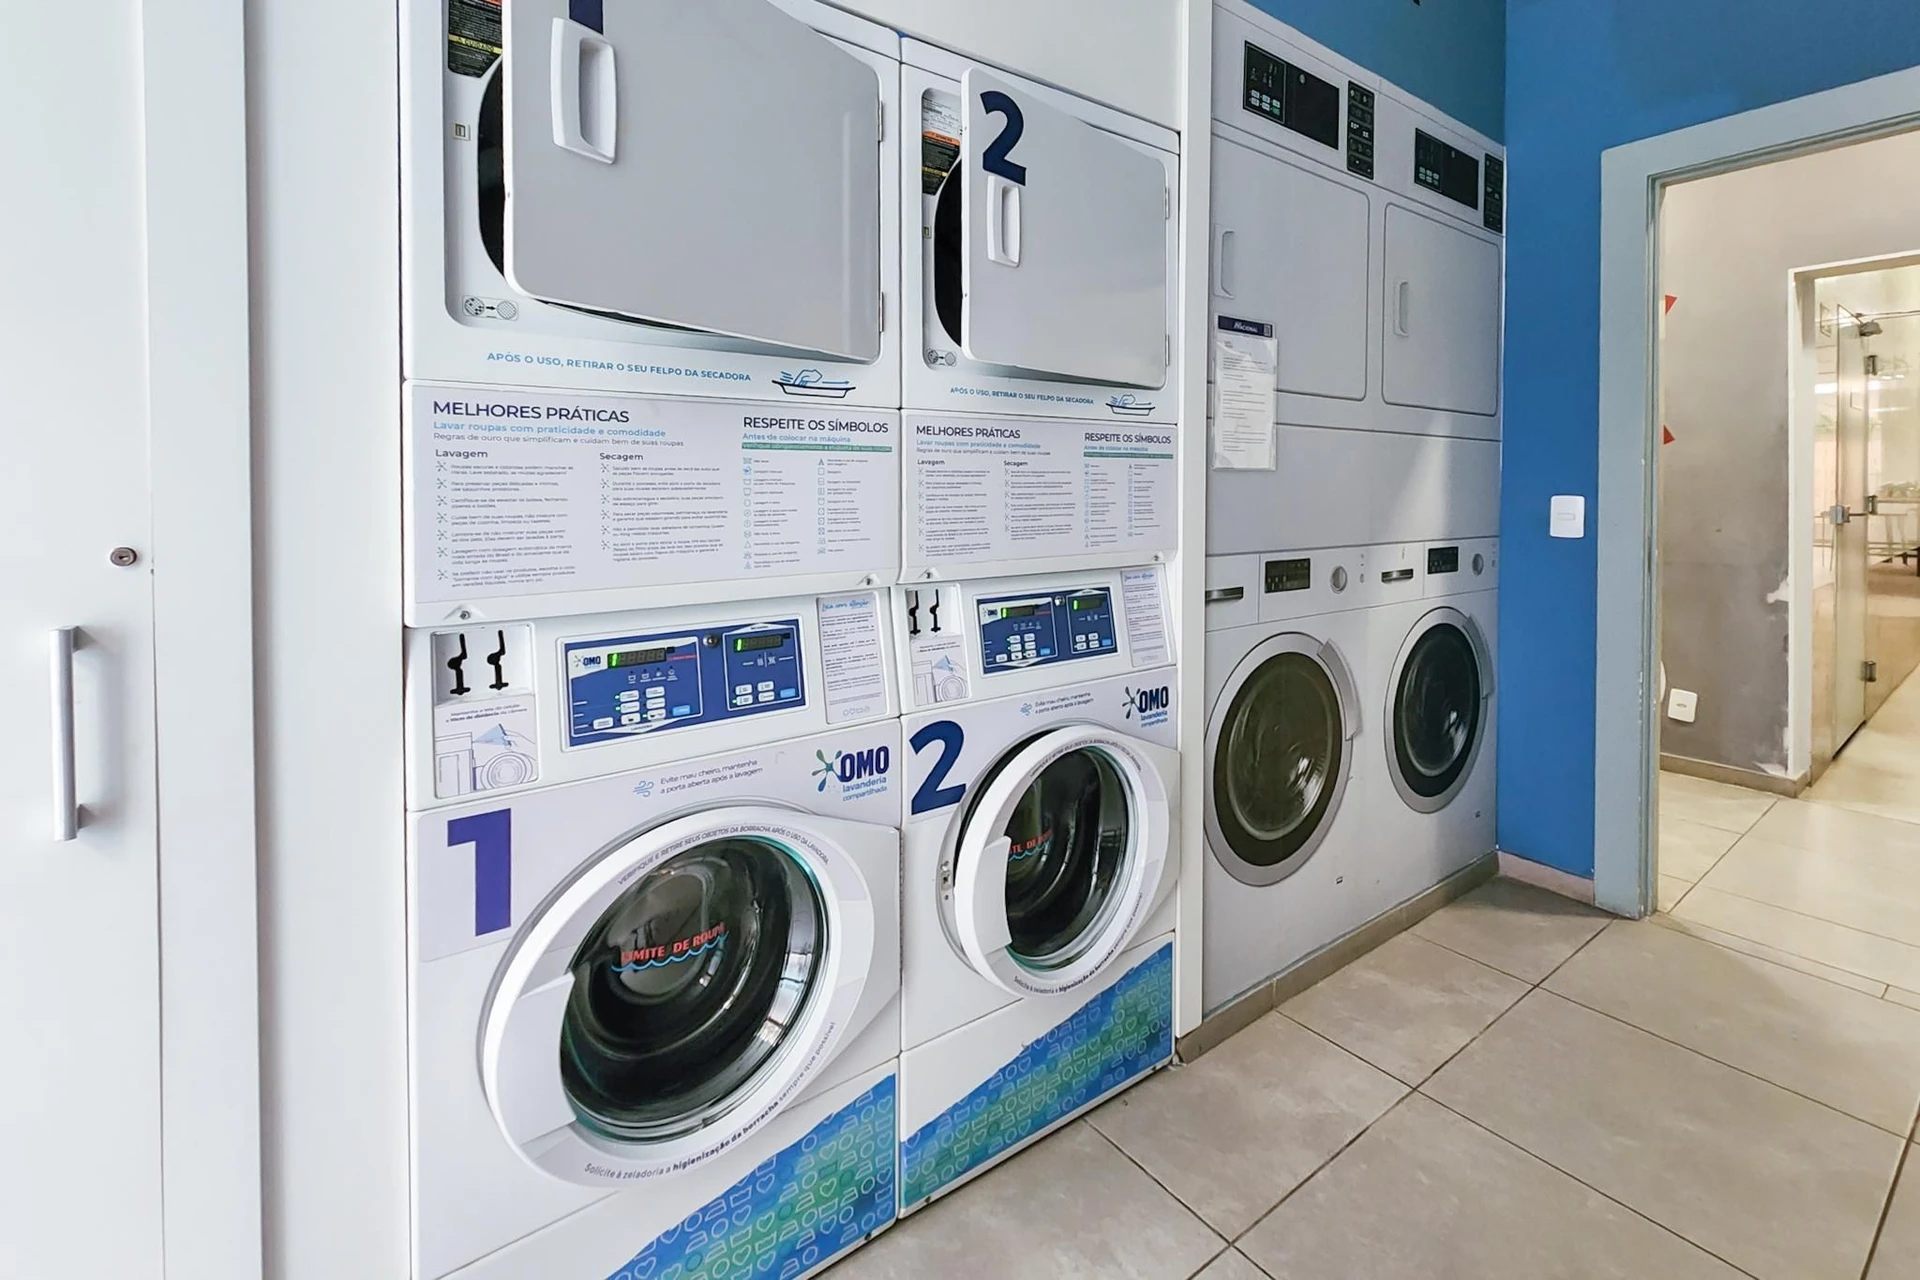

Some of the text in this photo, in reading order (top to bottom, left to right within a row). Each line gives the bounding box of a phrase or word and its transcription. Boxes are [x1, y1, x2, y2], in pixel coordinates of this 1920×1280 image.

[980, 90, 1027, 187] 2
[487, 352, 751, 381] APÓS O USO, RETIRAR O SEU FELPO DA SECADORA
[950, 387, 968, 395] APÓS
[992, 390, 1017, 399] RETIRAR
[1065, 396, 1094, 404] SECADORA
[434, 401, 630, 423] MELHORES PRÁTICAS
[434, 421, 465, 430] Lavar
[468, 424, 507, 432] roupas
[537, 426, 595, 434] praticidade
[607, 428, 666, 437] comodidade
[743, 416, 889, 433] RESPEITE OS SÍMBOLOS
[916, 425, 1020, 438] MELHORES PRÁTICAS
[434, 432, 465, 441] Regras
[820, 435, 851, 443] máquina
[1084, 432, 1171, 444] RESPEITE OS SÍMBOLOS
[435, 449, 488, 459] Lavagem
[599, 452, 644, 461] Secagem
[583, 655, 601, 666] OMO
[1140, 686, 1169, 713] OMO
[661, 776, 678, 784] Evite
[722, 760, 757, 771] mantenha
[839, 746, 889, 783] OMO
[909, 720, 967, 815] 2
[666, 784, 686, 793] porta
[687, 779, 710, 788] aberta
[711, 775, 728, 783] após
[734, 767, 763, 777] lavagem
[842, 777, 887, 793] lavanderia
[843, 786, 888, 802] compartilhada
[618, 857, 654, 885] VERIFIQUE
[661, 841, 683, 855] RETIRE
[684, 834, 701, 844] SEUS
[701, 827, 730, 839] OBJETOS
[740, 825, 771, 833] BORRACHA
[772, 827, 785, 836] APÓS
[791, 832, 801, 841] USO
[447, 808, 511, 936] 1
[621, 945, 665, 962] LIMITE
[673, 939, 690, 953] DE
[584, 1021, 836, 1180] Solicite à zeladoria a higienização da borracha sempre que possível
